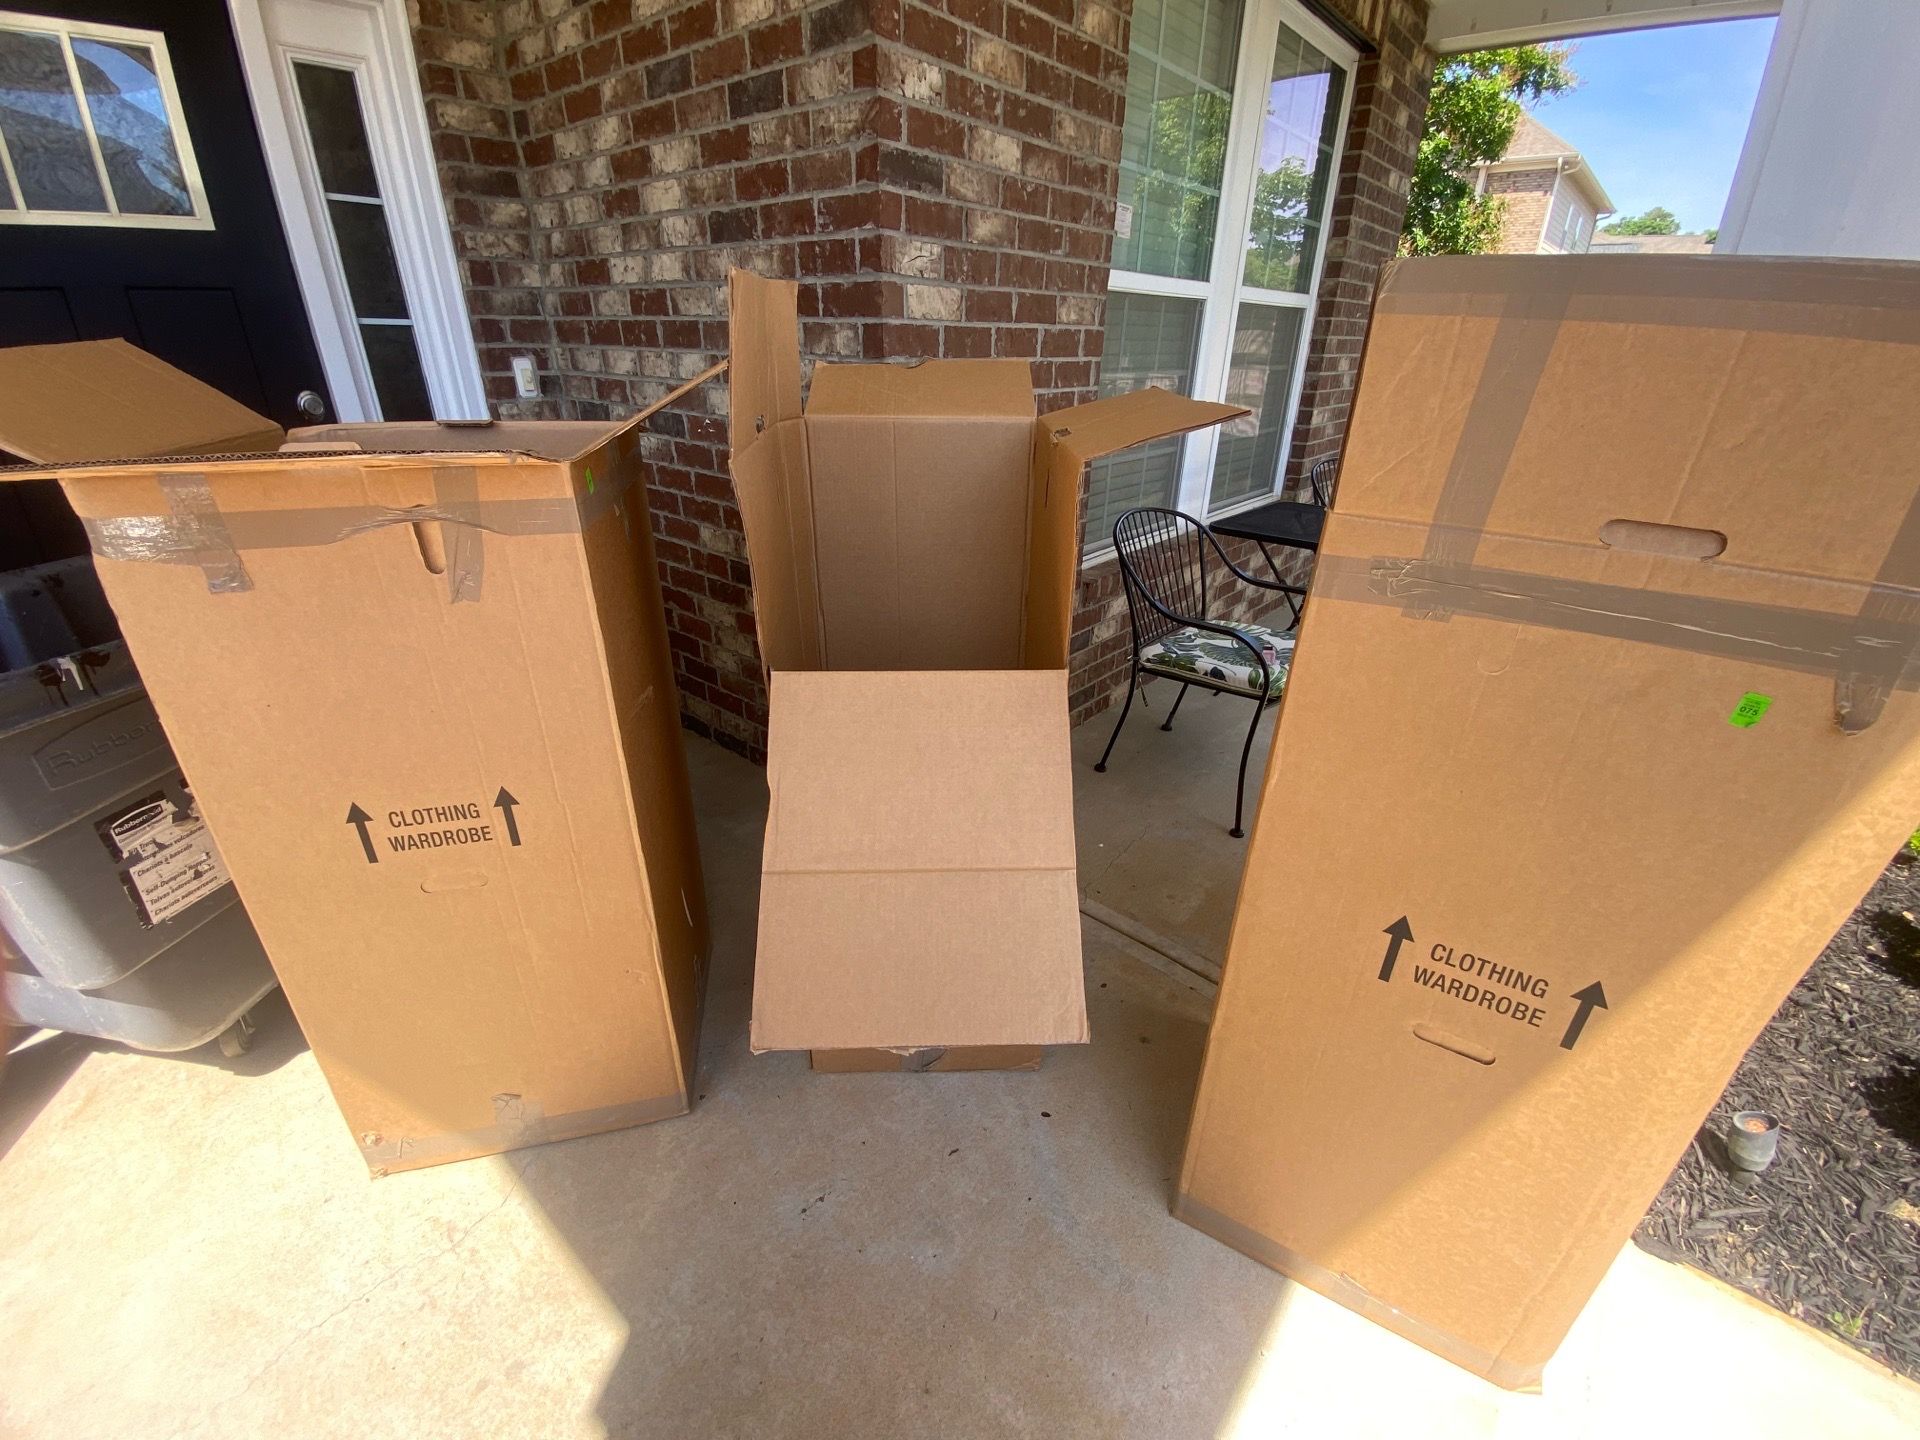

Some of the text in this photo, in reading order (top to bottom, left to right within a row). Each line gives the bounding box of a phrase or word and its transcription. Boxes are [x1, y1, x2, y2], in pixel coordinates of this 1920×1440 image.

[388, 802, 481, 828] CLOTHING
[387, 825, 493, 852] WARDROBE
[1429, 942, 1549, 999] CLOTHING
[1412, 964, 1546, 1028] WARDROBE
